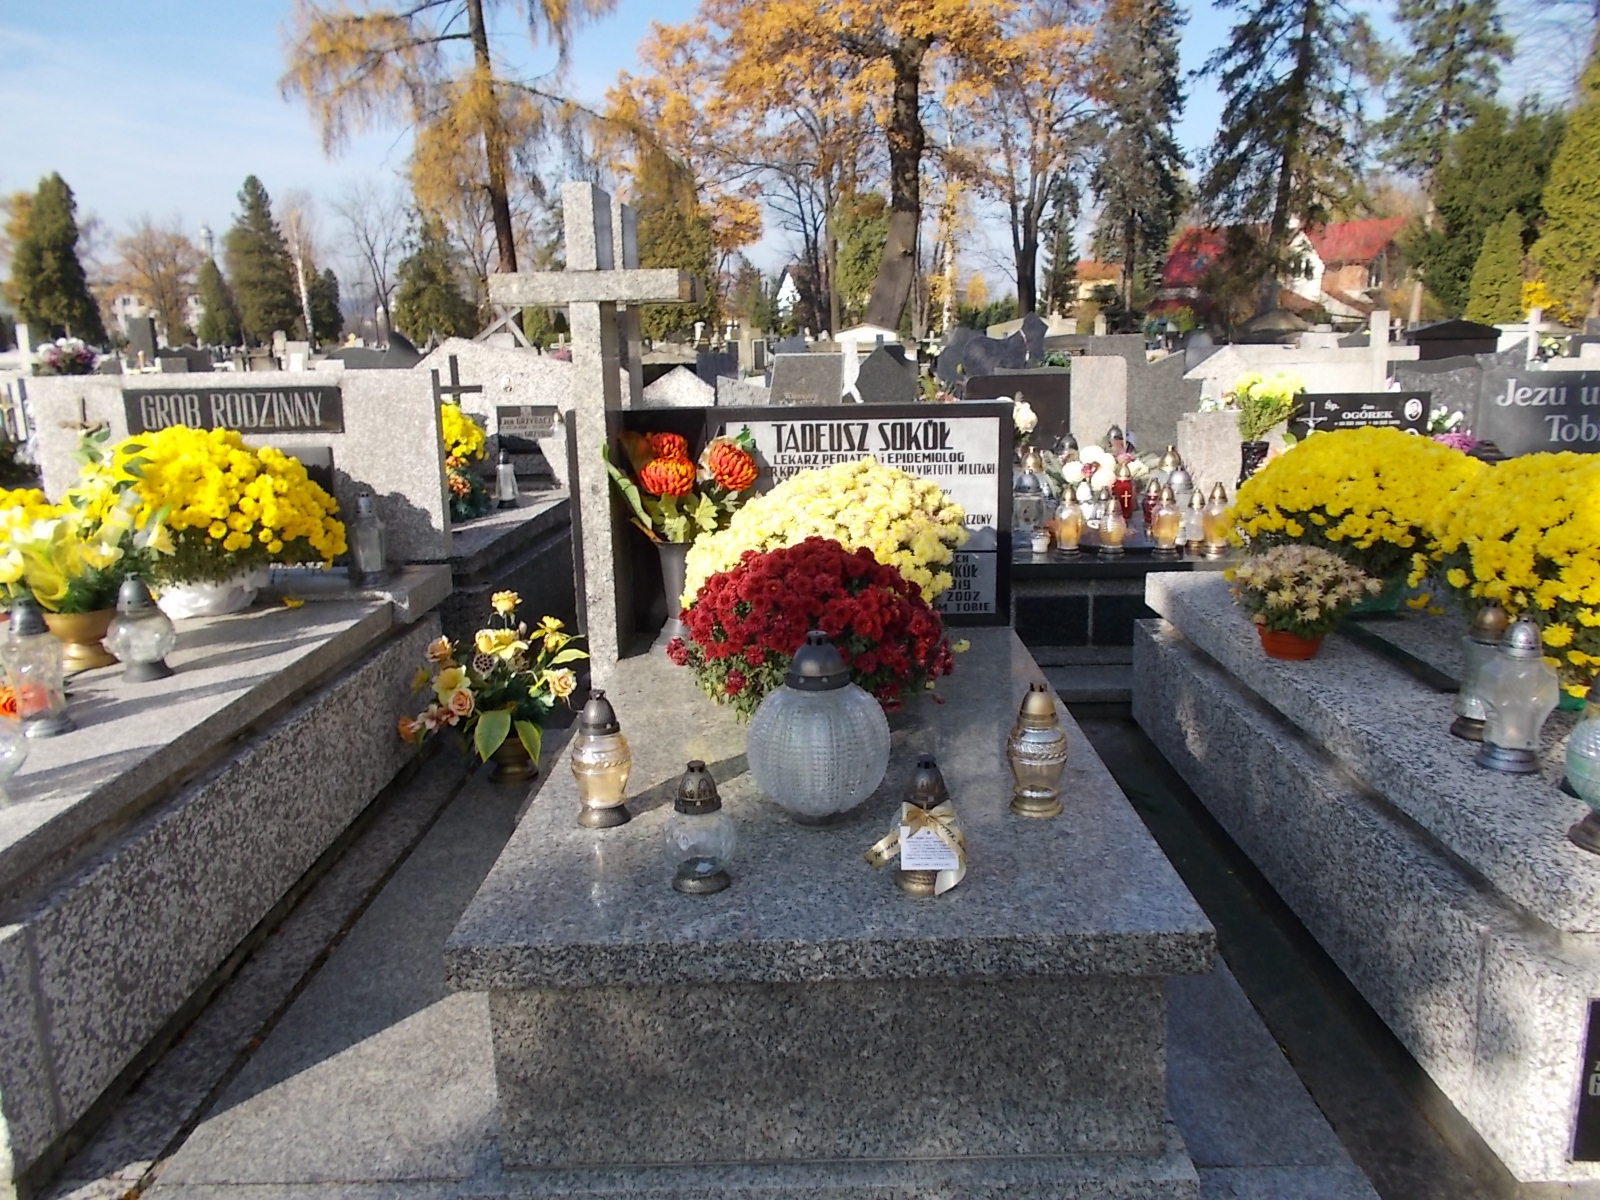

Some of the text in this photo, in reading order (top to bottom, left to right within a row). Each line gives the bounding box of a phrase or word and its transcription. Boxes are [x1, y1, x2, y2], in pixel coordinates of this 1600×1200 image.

[1496, 378, 1600, 406] Jezu u
[210, 391, 322, 428] RODZINNY
[1342, 407, 1393, 420] OGÓREK
[771, 423, 870, 453] TADEUSZ
[878, 420, 954, 451] SOKÓŁ
[1544, 414, 1600, 442] Tob
[773, 454, 819, 465] LEKARZ
[887, 452, 965, 463] EPIDEMIOLOG
[916, 464, 953, 475] VIRTUTI
[957, 463, 995, 475] MILITARI
[956, 602, 990, 612] TOBIE
